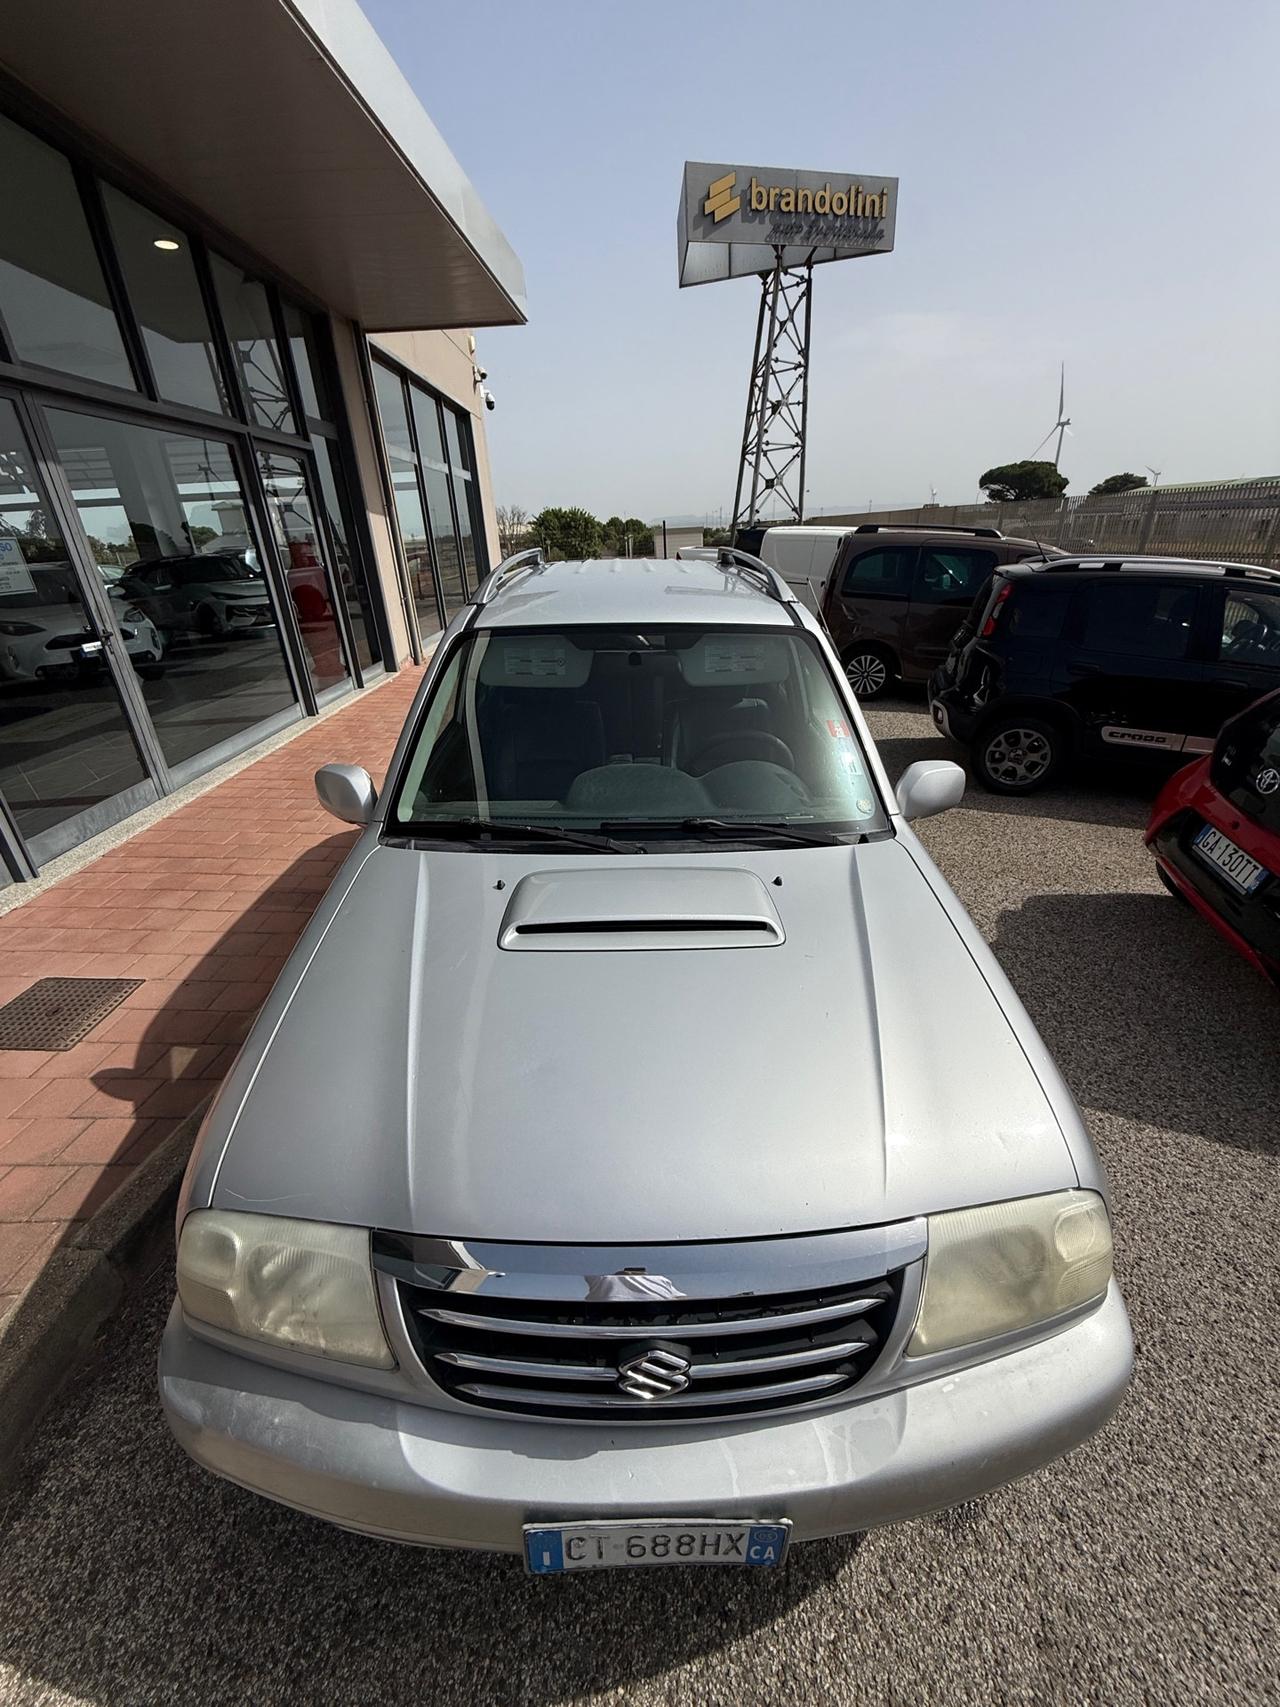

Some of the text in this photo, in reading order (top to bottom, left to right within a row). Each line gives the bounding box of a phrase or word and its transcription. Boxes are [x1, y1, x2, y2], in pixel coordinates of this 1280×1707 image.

[750, 177, 888, 218] brandolini
[566, 1532, 746, 1561] CT 688HX
[750, 1545, 775, 1560] CA
